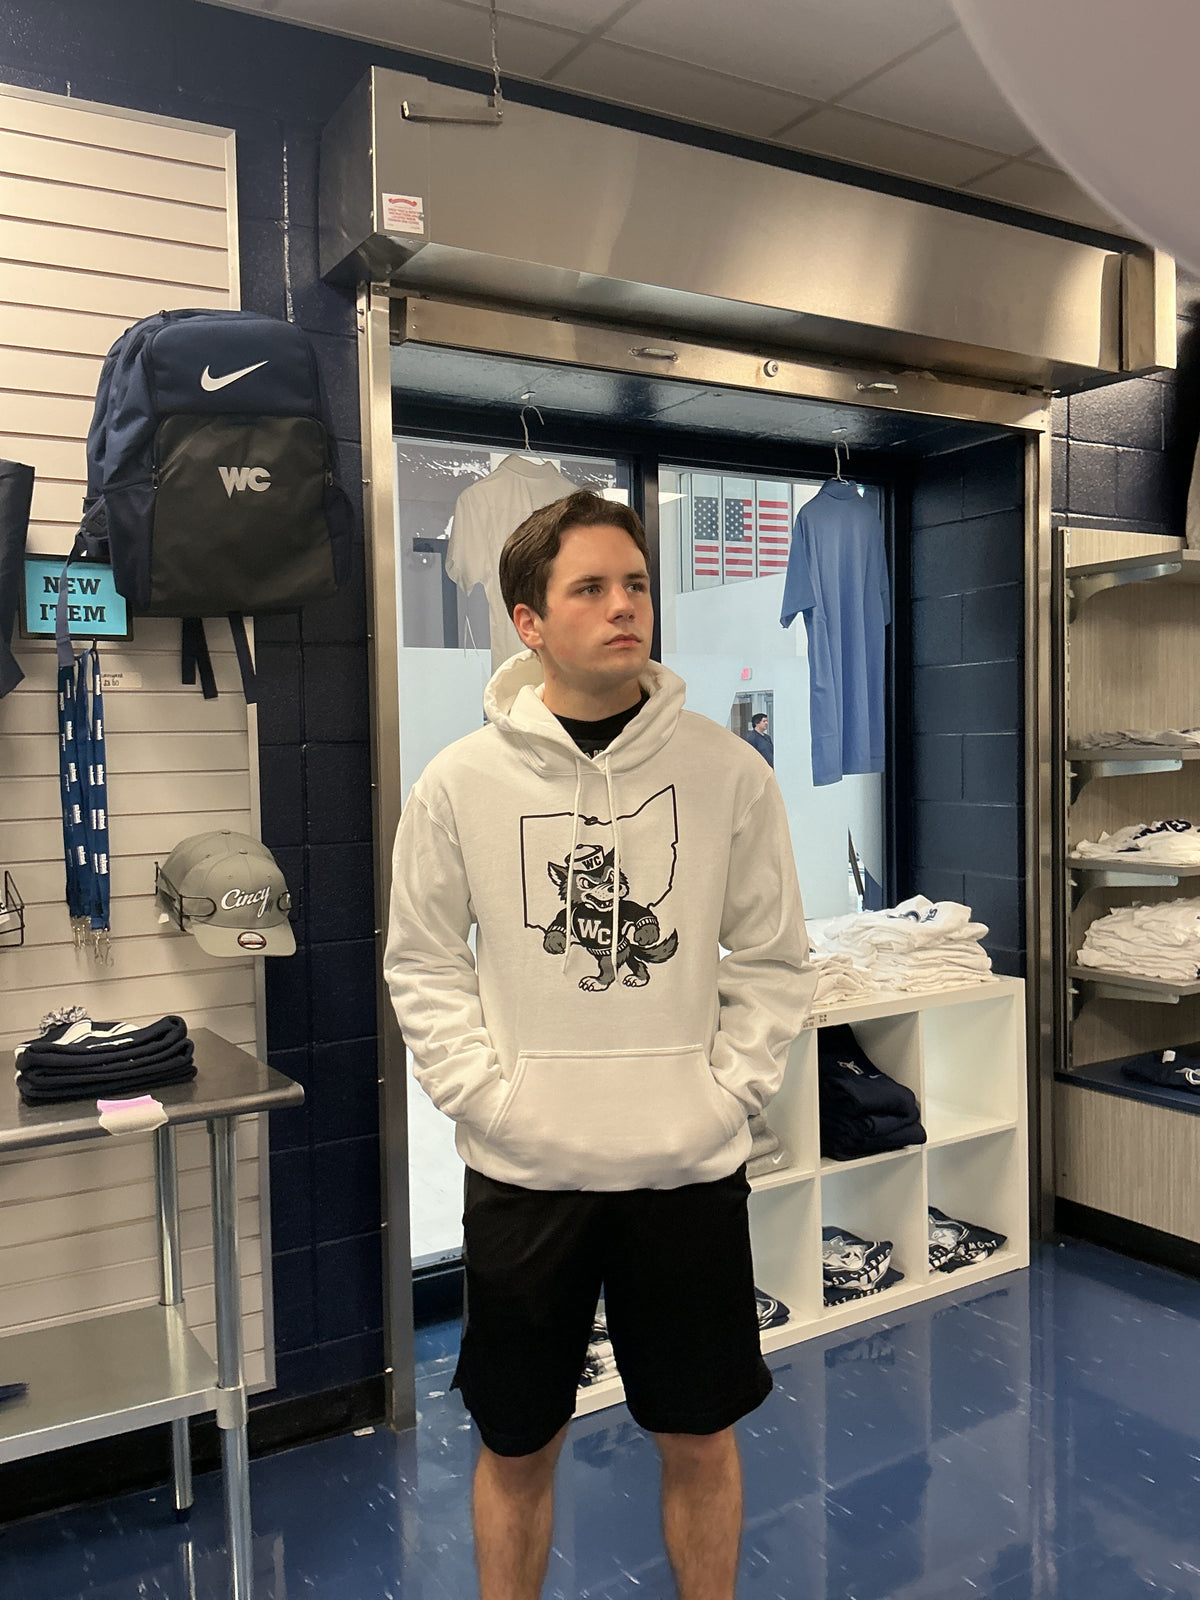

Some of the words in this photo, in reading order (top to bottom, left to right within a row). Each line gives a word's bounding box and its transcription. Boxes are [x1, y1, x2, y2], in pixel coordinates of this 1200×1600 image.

[218, 466, 272, 499] WC
[43, 576, 101, 595] NEW
[582, 856, 602, 870] WC
[221, 886, 271, 918] Cincy
[577, 918, 611, 945] WC
